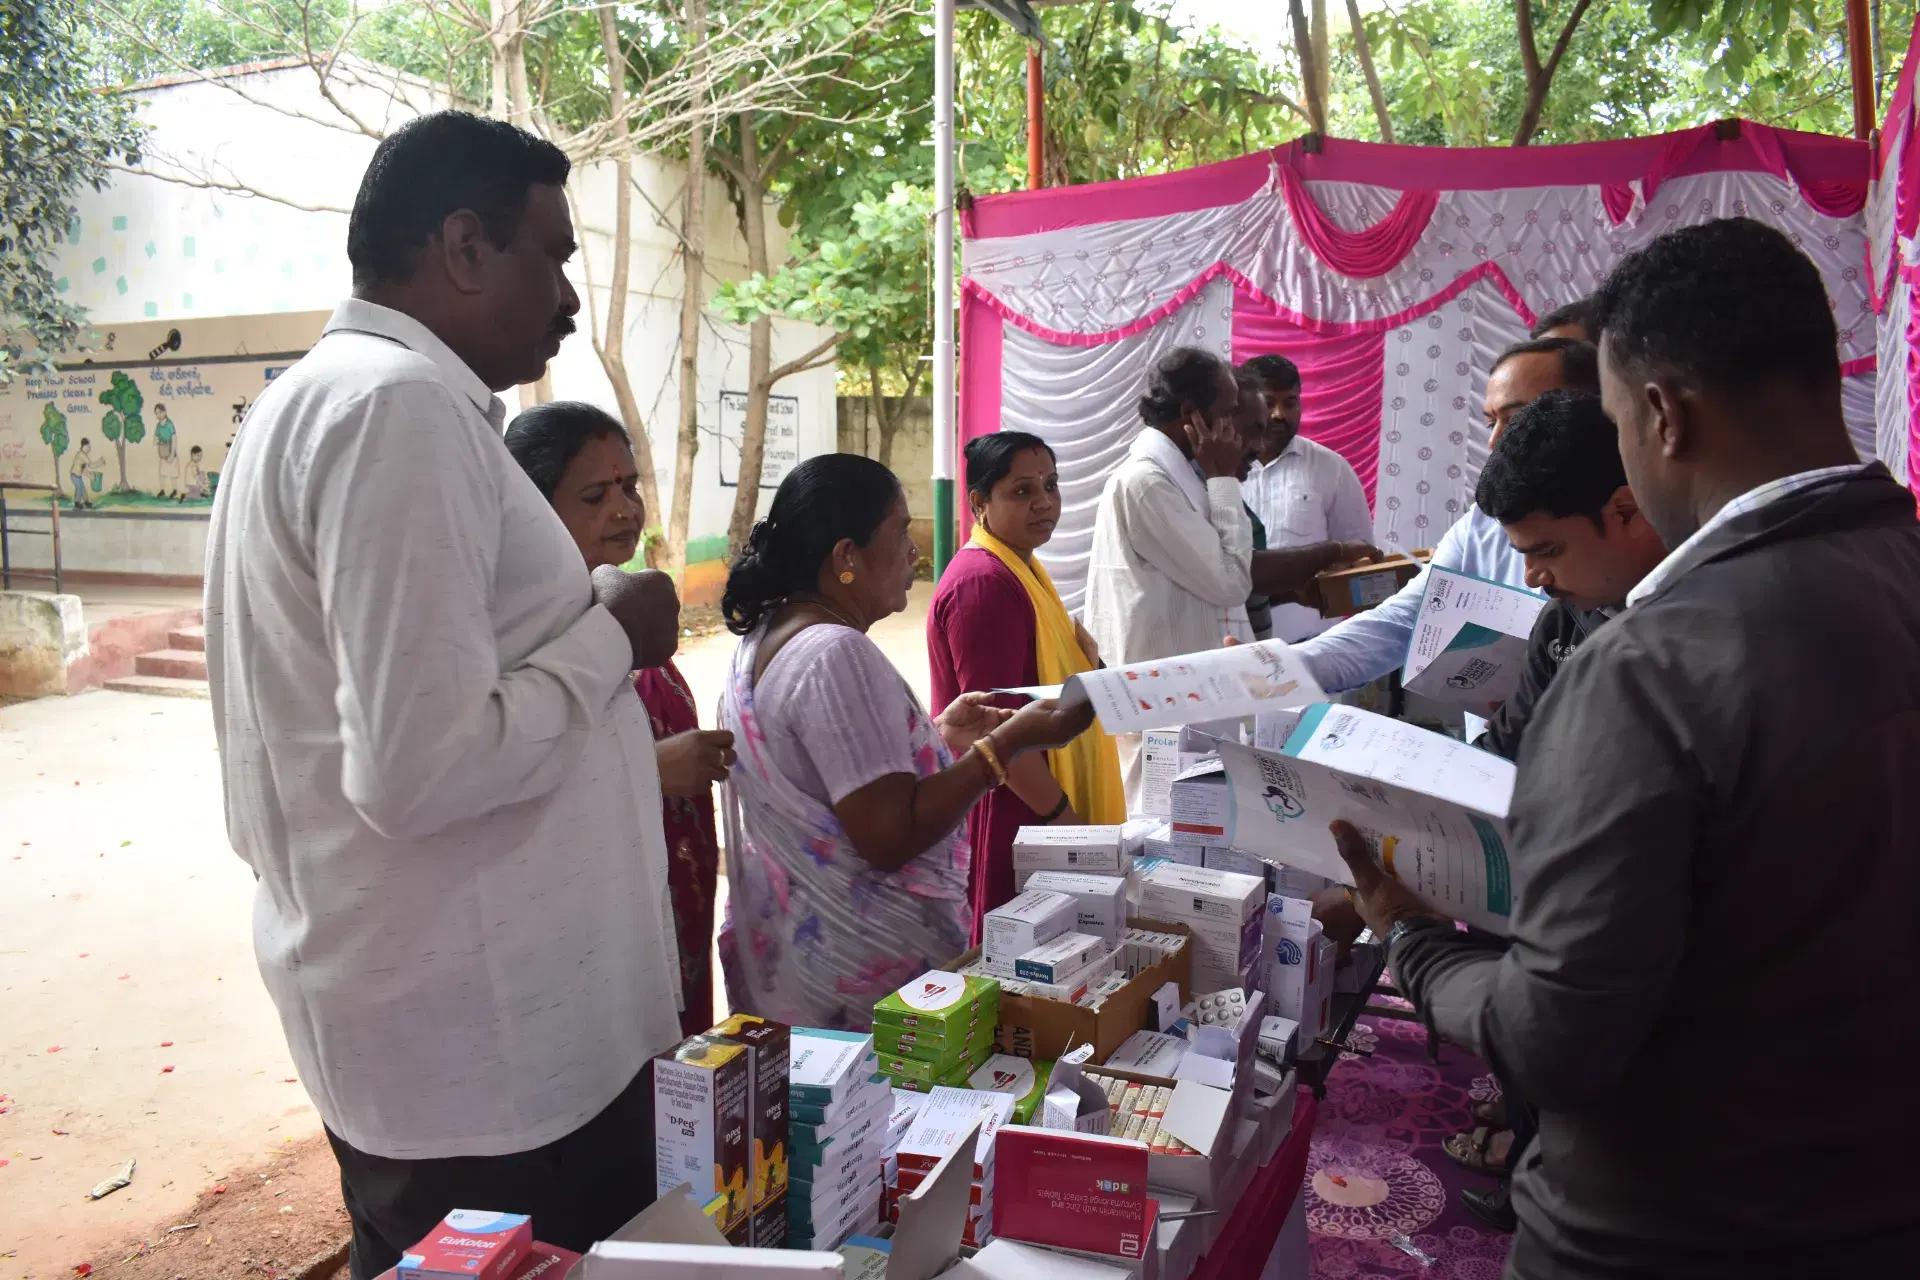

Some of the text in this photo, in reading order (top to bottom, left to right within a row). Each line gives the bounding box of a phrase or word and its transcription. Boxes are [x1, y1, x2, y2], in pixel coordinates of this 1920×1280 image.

[69, 374, 96, 385] School
[1147, 736, 1178, 747] Prolar
[670, 1115, 695, 1131] D-Peg
[1095, 1179, 1128, 1193] adek
[1036, 1188, 1061, 1200] Tablets
[1062, 1192, 1087, 1204] Extract
[1051, 1199, 1141, 1221] Multivitamin with Zinc and
[1109, 1198, 1142, 1210] Curcuma
[437, 1235, 498, 1249] EuKolon
